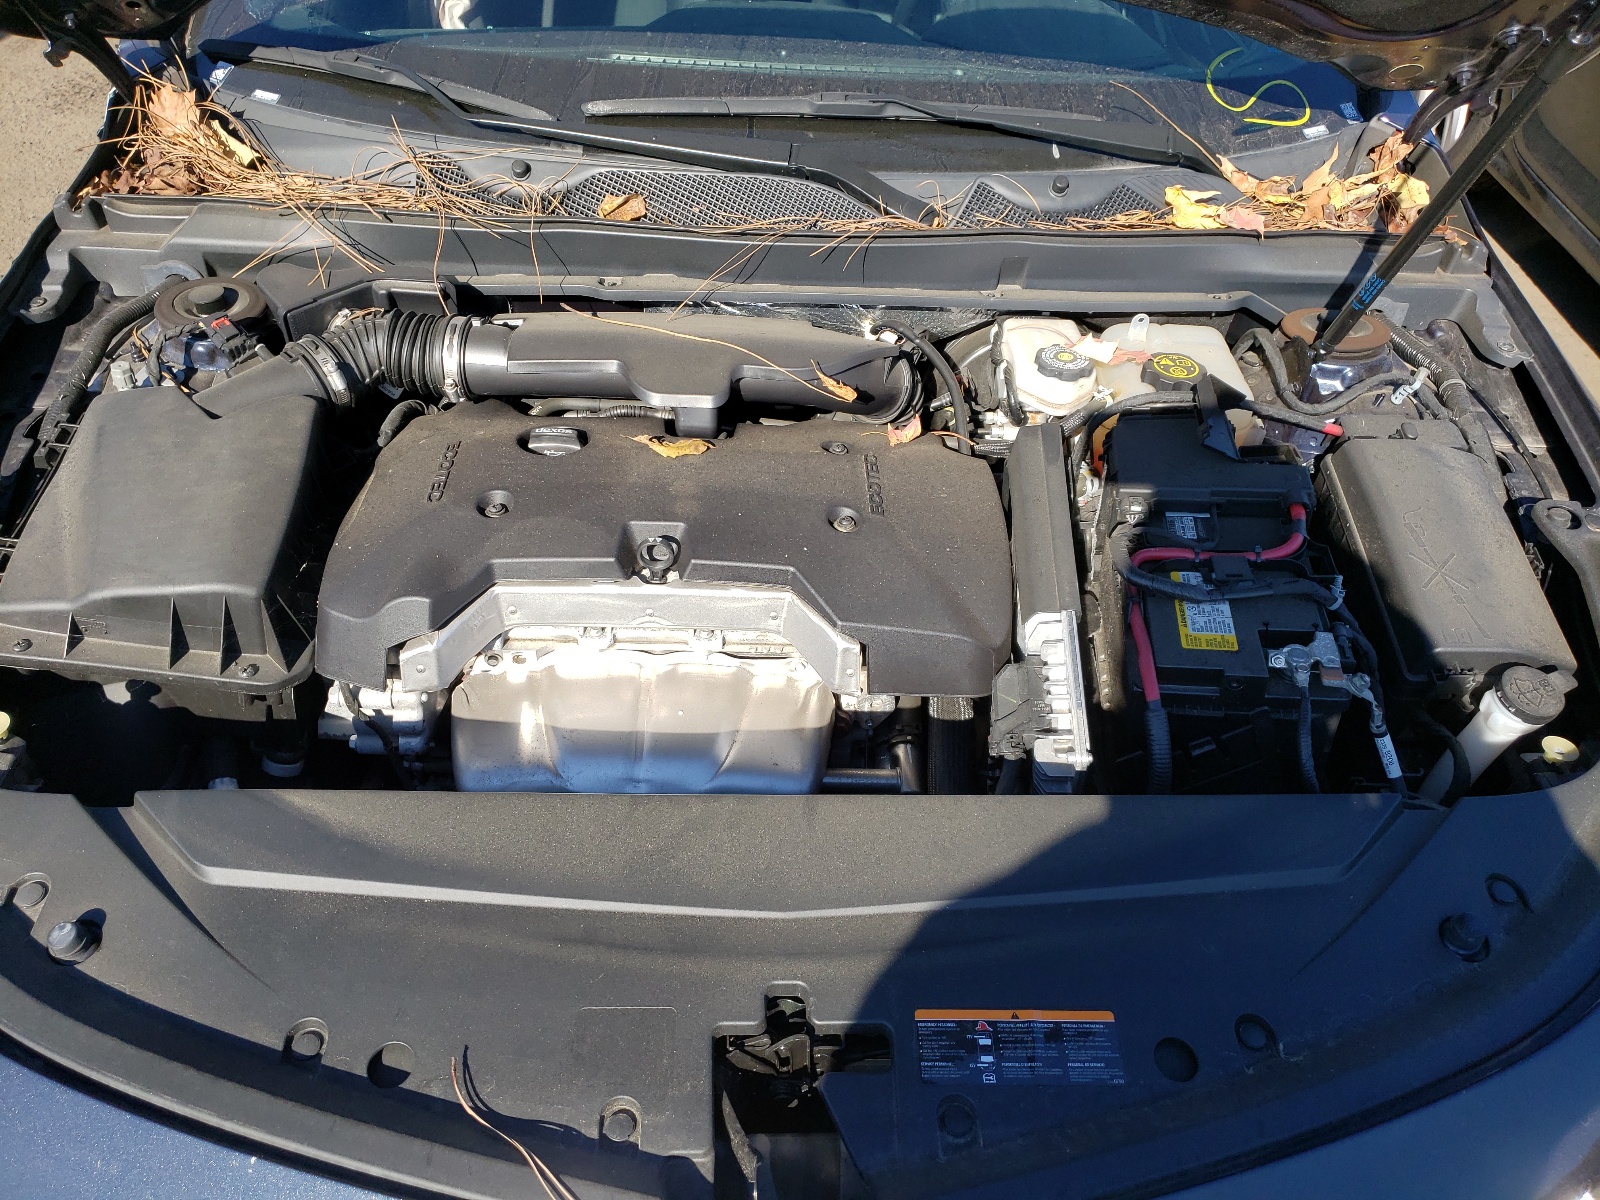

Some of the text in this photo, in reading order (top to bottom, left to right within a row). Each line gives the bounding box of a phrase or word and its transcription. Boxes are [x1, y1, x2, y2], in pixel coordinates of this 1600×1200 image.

[535, 427, 573, 435] dexos
[427, 441, 462, 502] ECOTEC
[863, 453, 885, 517] ECOTEC
